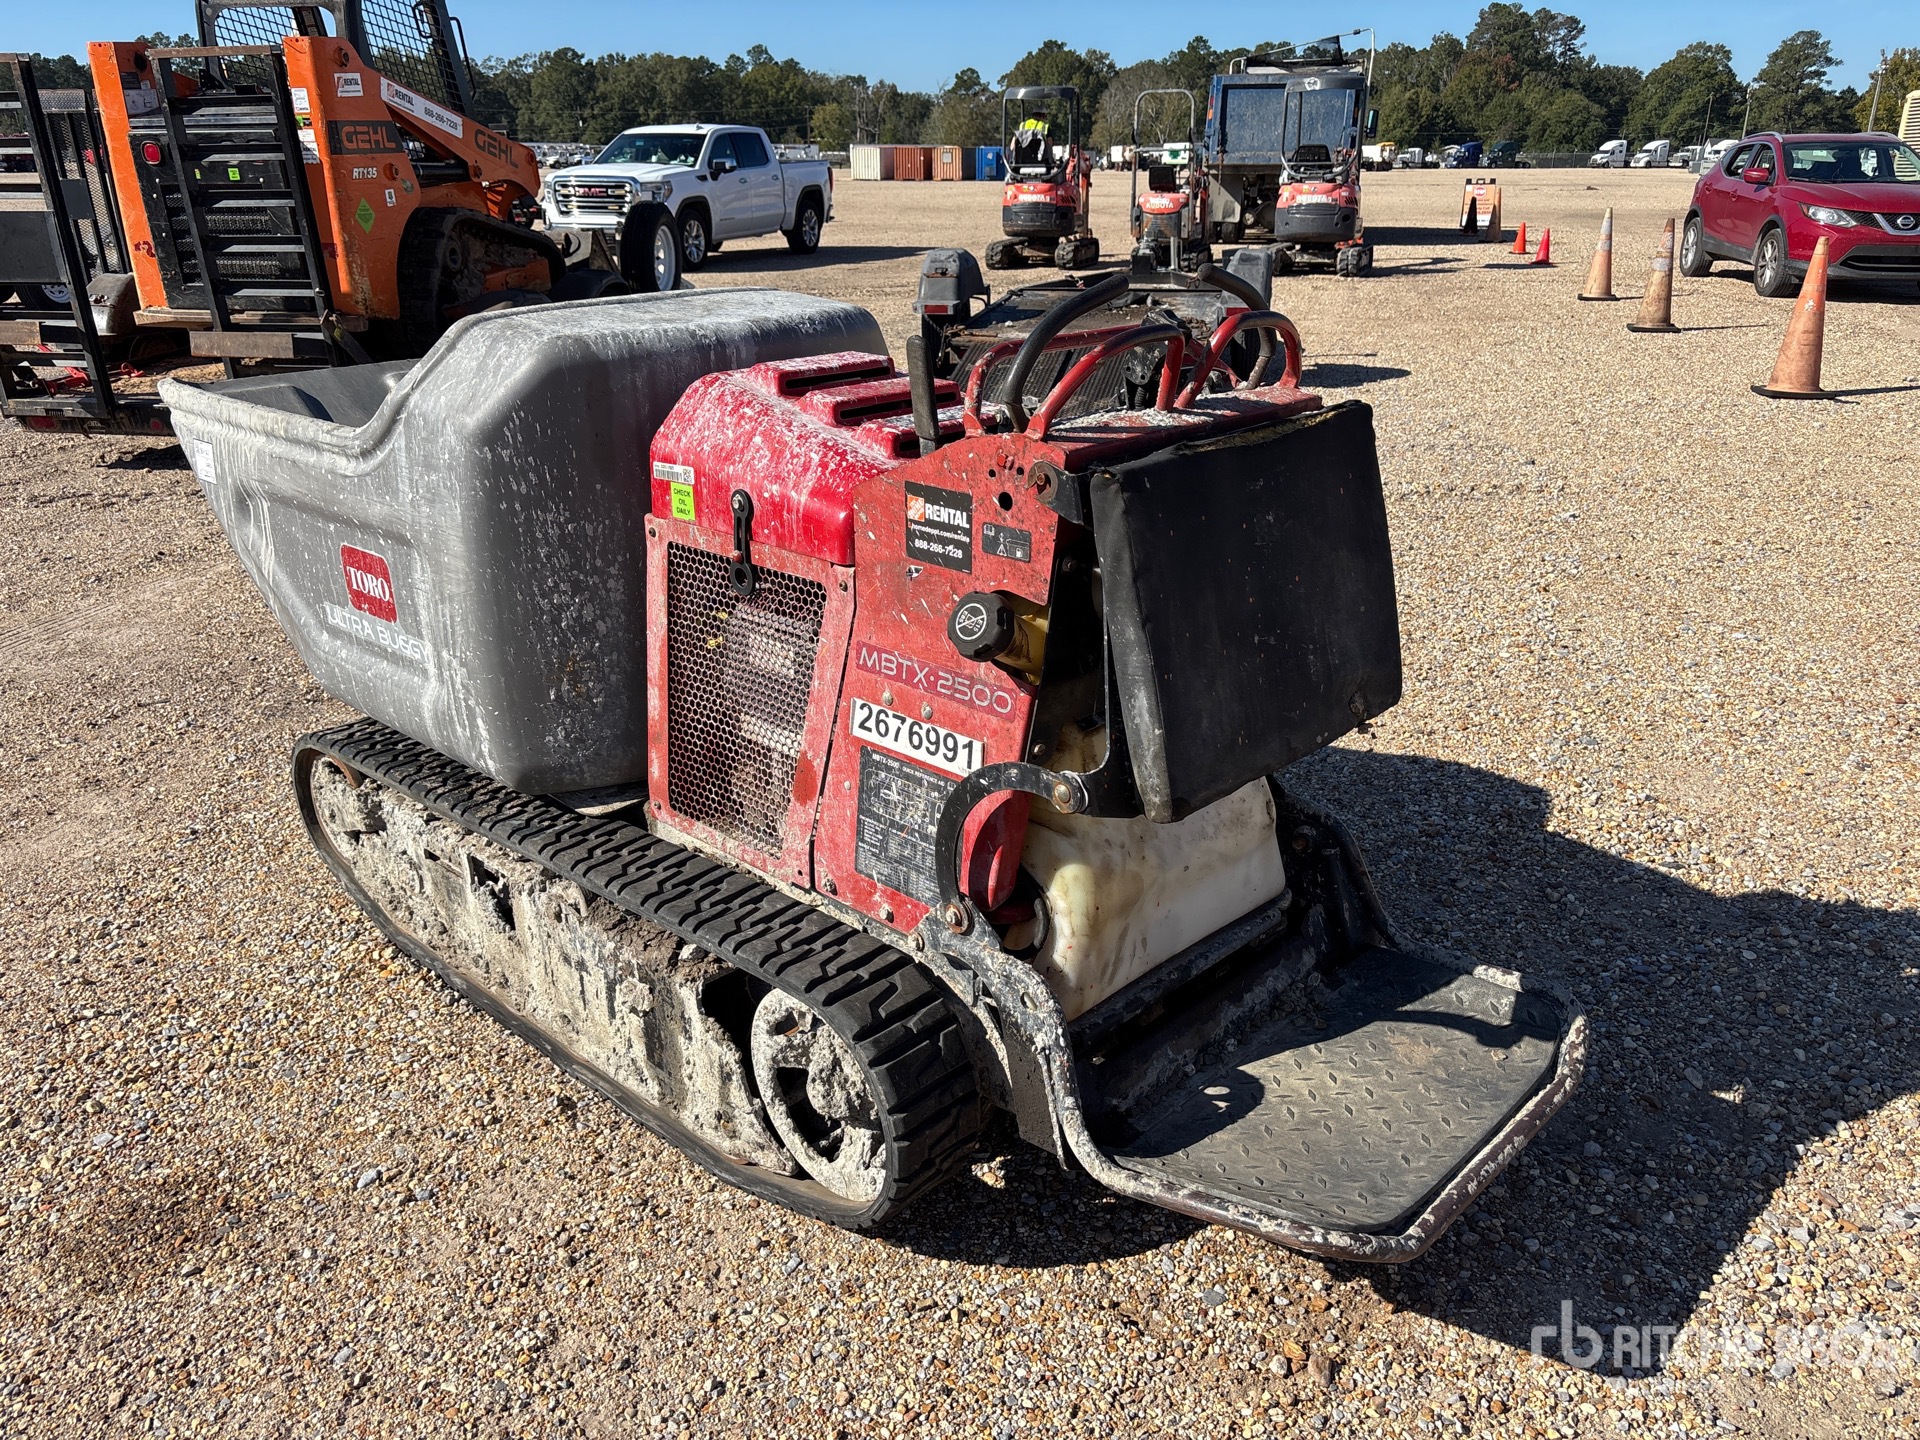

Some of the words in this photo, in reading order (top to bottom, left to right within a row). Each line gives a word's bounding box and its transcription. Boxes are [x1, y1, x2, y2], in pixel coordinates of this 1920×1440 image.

[343, 77, 360, 86] RENTAL
[394, 88, 415, 106] RENTAL
[341, 125, 396, 149] GEHL
[474, 128, 519, 169] GEHL
[352, 167, 378, 180] RT135
[673, 487, 691, 497] CHECK
[676, 506, 691, 515] DAILY
[678, 499, 688, 507] OIL
[925, 503, 970, 528] RENTAL
[914, 538, 963, 559] 888-266-7228
[346, 566, 390, 601] TORO
[326, 604, 375, 640] ULTRA
[377, 625, 431, 663] BUGGY
[858, 702, 974, 770] 2676991
